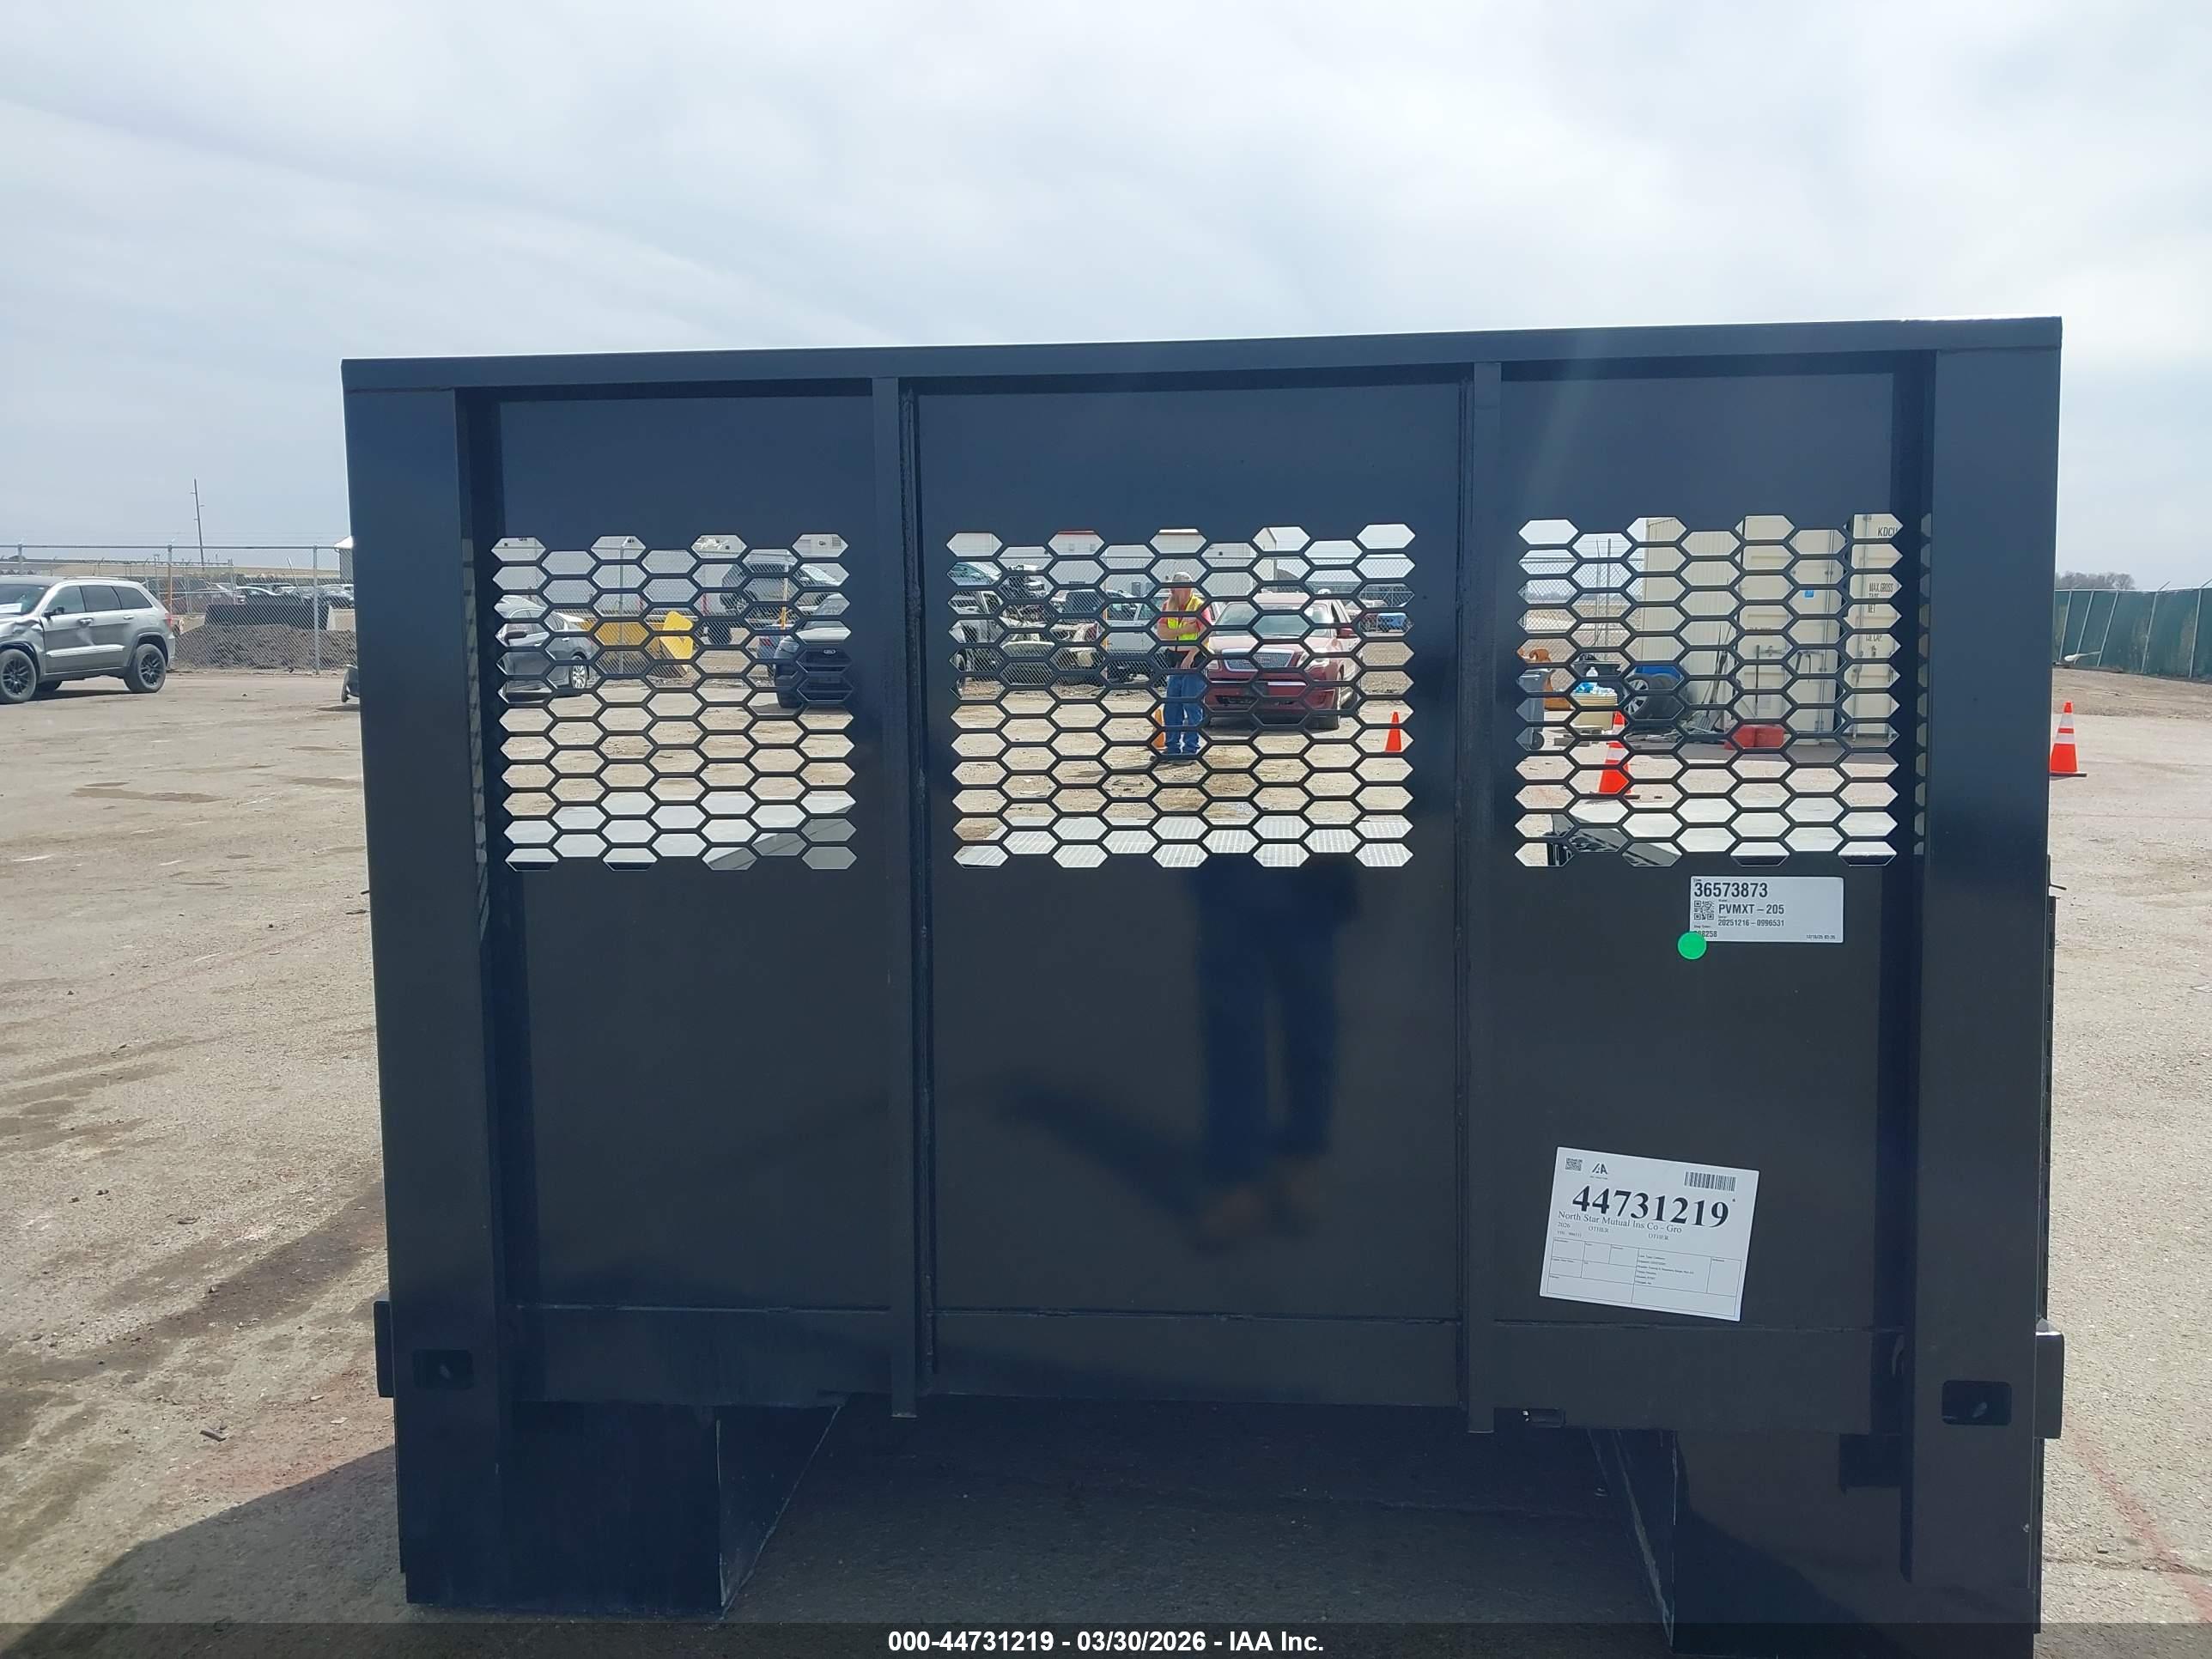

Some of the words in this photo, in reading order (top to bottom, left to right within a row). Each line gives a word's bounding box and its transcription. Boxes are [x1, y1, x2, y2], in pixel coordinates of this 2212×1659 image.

[1694, 882, 1768, 897] 36573873
[1572, 1185, 1729, 1228] 44731219
[1558, 1211, 1581, 1221] North
[1583, 1213, 1600, 1224] Star
[1601, 1217, 1630, 1227] Mutual
[1633, 1220, 1645, 1229] Ins
[1667, 1224, 1682, 1233] Gro
